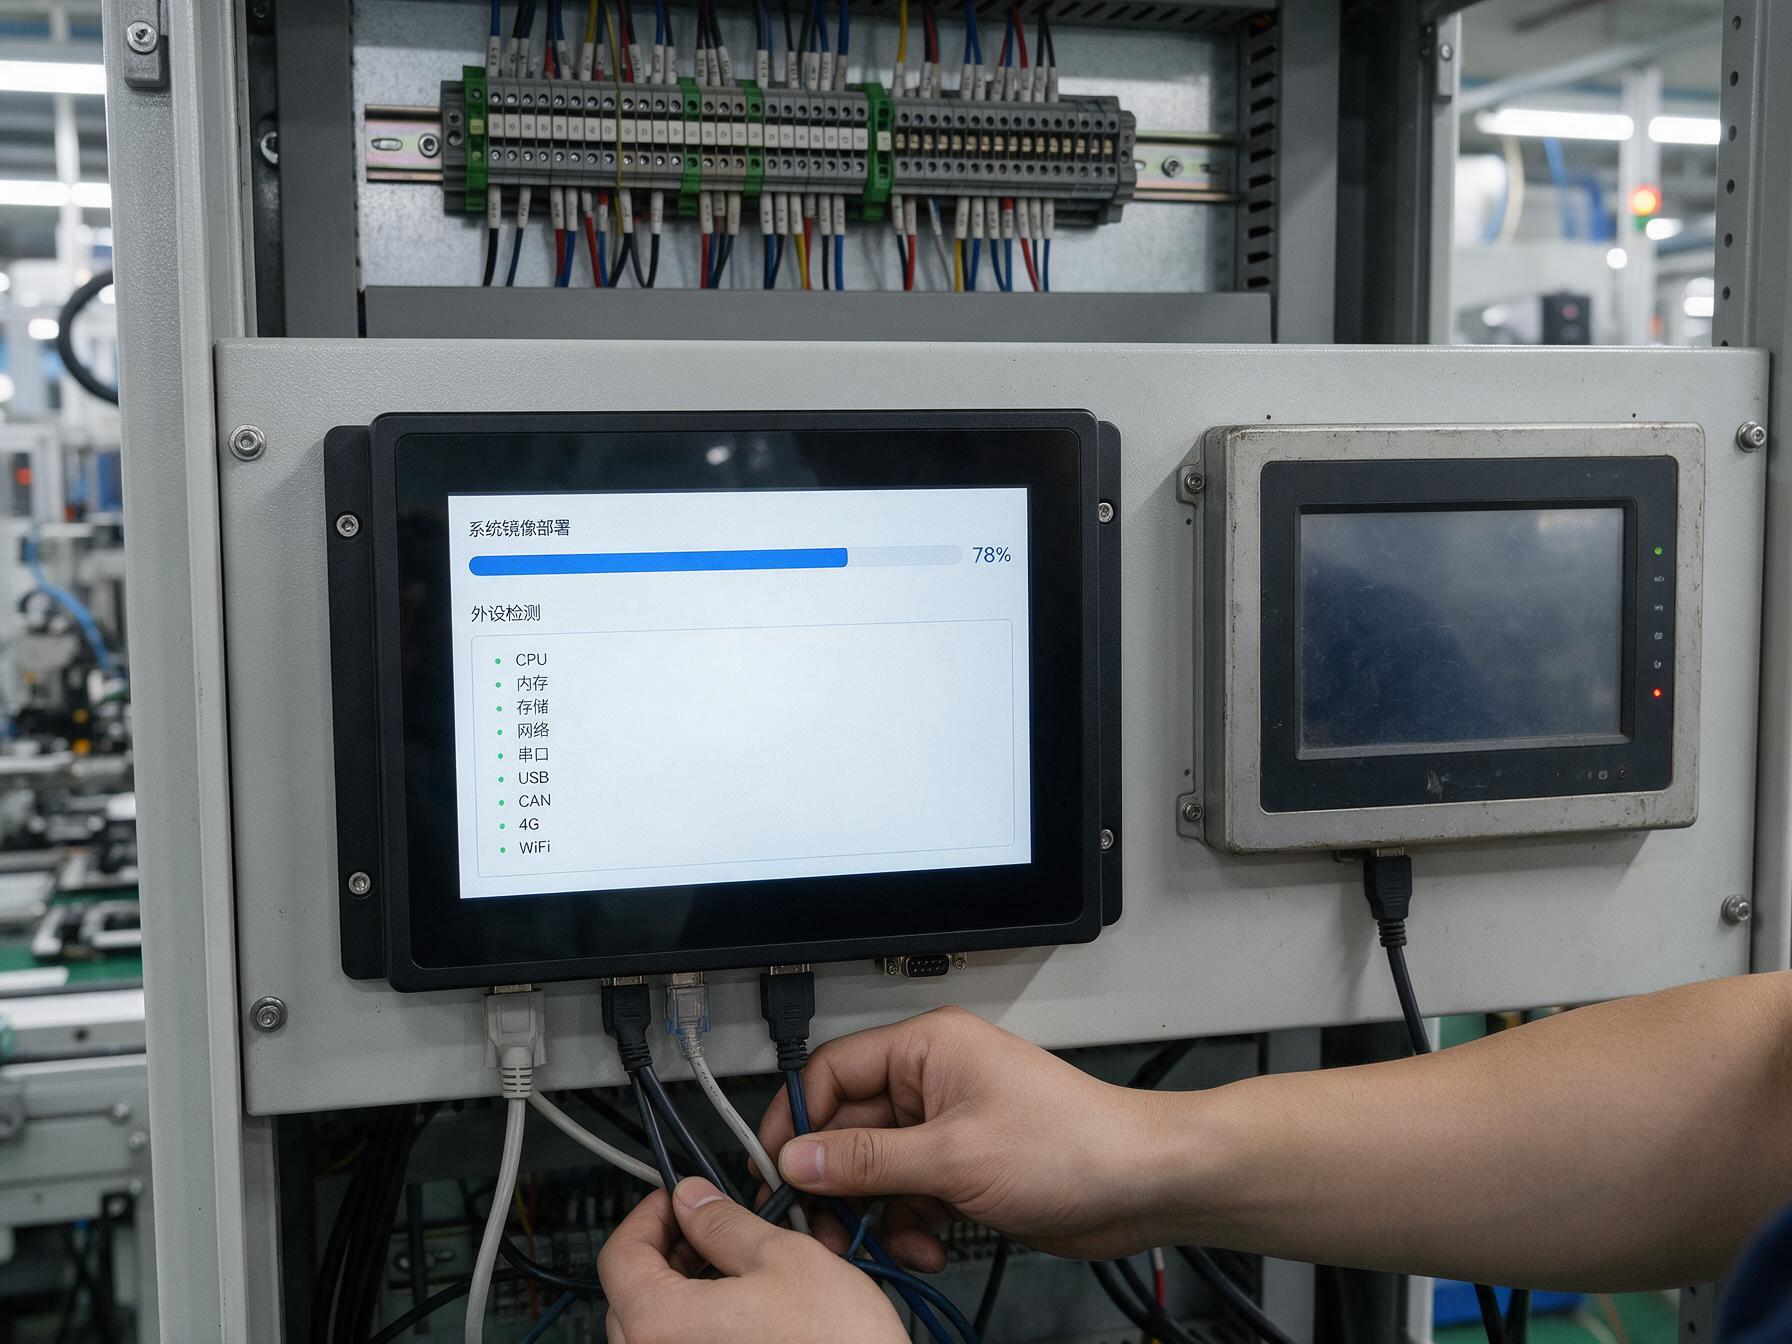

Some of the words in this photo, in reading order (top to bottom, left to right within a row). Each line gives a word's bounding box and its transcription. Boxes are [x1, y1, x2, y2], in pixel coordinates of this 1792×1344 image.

[468, 518, 571, 538] 系统镜像部署
[972, 546, 1012, 564] 78%
[470, 603, 541, 623] 外设检测
[515, 652, 547, 667] CPU
[517, 674, 549, 693] 内存
[516, 698, 550, 716] 存储
[517, 720, 550, 740] 网络
[518, 745, 549, 764] 串口
[518, 770, 550, 785] USB
[518, 793, 551, 808] CAN
[518, 817, 540, 831] 4G
[518, 839, 551, 855] WiFi
